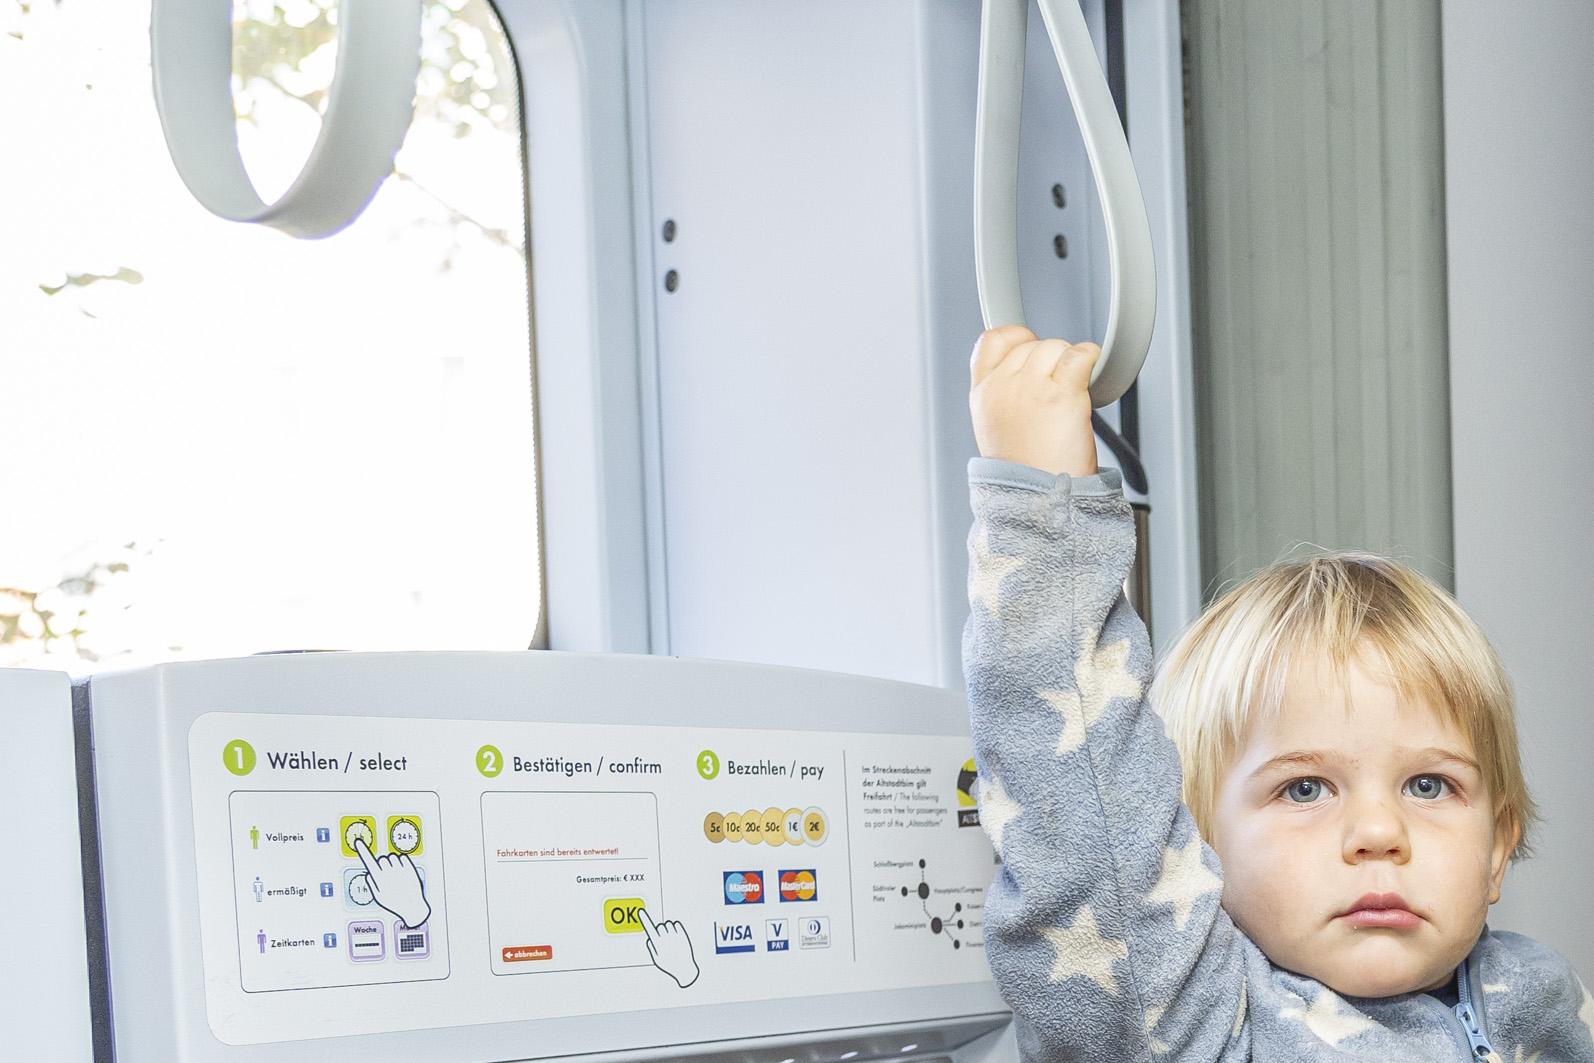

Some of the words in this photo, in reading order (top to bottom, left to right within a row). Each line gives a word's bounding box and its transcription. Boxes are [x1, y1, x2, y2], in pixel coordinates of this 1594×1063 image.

[234, 746, 244, 769] 1
[266, 751, 339, 771] Wählen
[344, 751, 353, 774] /
[359, 752, 407, 771] select
[482, 751, 497, 772] 2
[513, 756, 592, 777] Bestätigen
[596, 756, 604, 776] /
[609, 757, 662, 774] confirm
[702, 755, 714, 775] 3
[728, 759, 787, 776] Bezahlen
[789, 760, 797, 778] /
[801, 765, 825, 780] pay
[862, 780, 874, 788] der
[916, 780, 927, 789] gilt
[863, 792, 893, 800] Freifahrt
[900, 792, 911, 800] The
[912, 792, 939, 803] following
[907, 806, 915, 814] for
[710, 822, 721, 833] 5c
[726, 822, 740, 833] 10c
[745, 822, 760, 832] 20c
[765, 822, 780, 832] 50c
[789, 822, 798, 831] 1€
[809, 822, 820, 831] 2€
[895, 819, 904, 827] the
[265, 833, 304, 844] Vollpreis
[398, 832, 407, 841] 24
[408, 832, 413, 840] h
[497, 849, 538, 857] Fahrkarten
[540, 848, 555, 857] sind
[557, 848, 582, 856] bereits
[583, 847, 619, 856] entwertet!
[576, 875, 622, 884] Gesamtpreis:
[623, 874, 628, 882] €
[267, 885, 307, 897] ermäßigt
[729, 882, 760, 893] Maestro
[781, 880, 815, 892] MasterCard
[610, 906, 638, 924] OK
[354, 926, 377, 934] Woche
[718, 924, 753, 941] VISA
[771, 923, 782, 937] V
[270, 938, 315, 948] Zeitkarten
[771, 941, 785, 950] PAY
[514, 950, 547, 959] abbrechen
